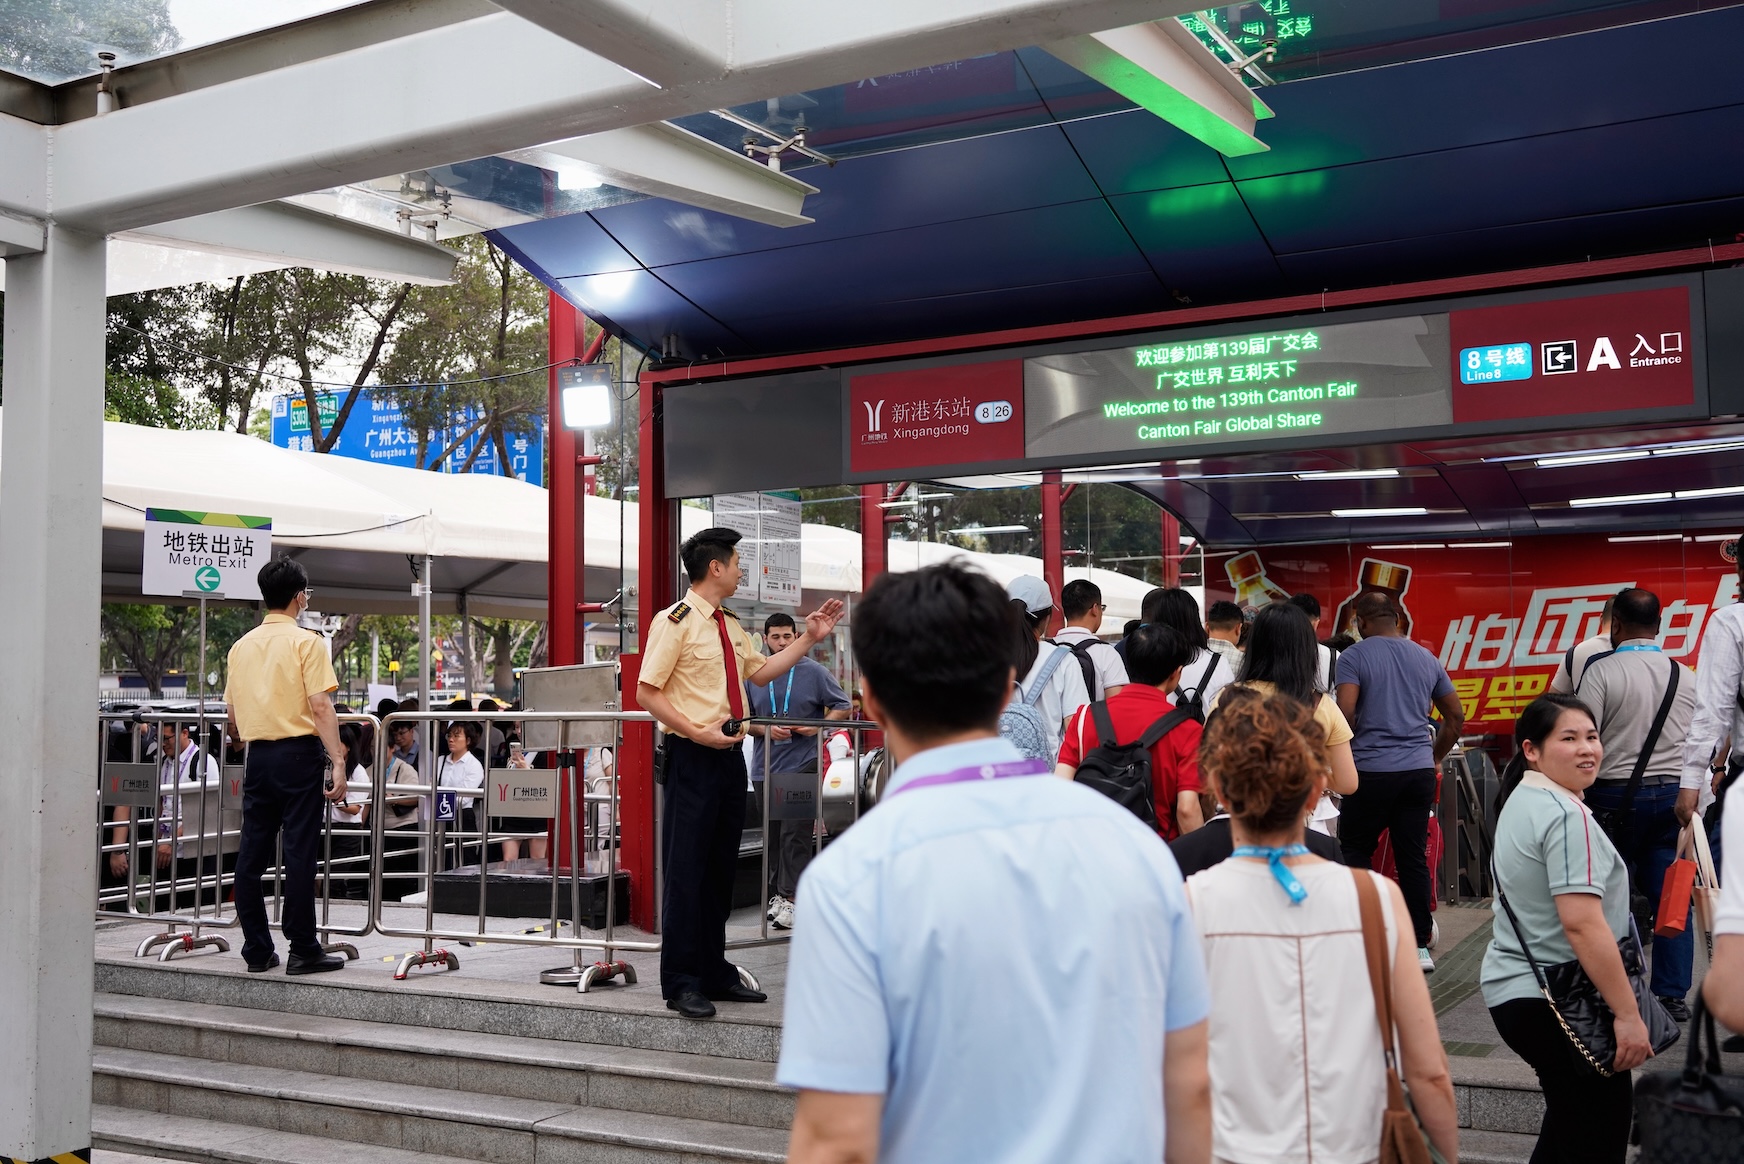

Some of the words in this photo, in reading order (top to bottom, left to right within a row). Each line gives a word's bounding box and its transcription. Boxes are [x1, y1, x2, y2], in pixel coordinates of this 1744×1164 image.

[1136, 331, 1319, 367] 欢迎参加第139届广交会
[1586, 337, 1622, 371] A
[1629, 332, 1683, 356] 入口
[1467, 346, 1526, 370] 8号线
[1630, 355, 1682, 368] Entrance
[1157, 367, 1223, 390] 广交世界
[1228, 359, 1298, 383] 互利天下
[891, 396, 971, 424] 新港东站
[982, 407, 990, 418] 8
[995, 405, 1010, 418] 26
[1104, 401, 1170, 418] Welcome
[1173, 398, 1189, 412] to
[1192, 395, 1216, 411] the
[1219, 389, 1264, 407] 139th
[1267, 384, 1323, 403] Canton
[1327, 382, 1358, 398] Fair
[893, 423, 969, 440] Xingangdong
[1138, 421, 1190, 439] Canton
[1194, 419, 1222, 435] Fair
[1226, 414, 1273, 431] Global
[1277, 411, 1322, 428] Share
[370, 448, 407, 460] Guangzhou
[163, 530, 254, 557] 地铁出站
[169, 552, 213, 567] Metro
[218, 556, 247, 569] Exit
[513, 787, 548, 797] 广州地铁
